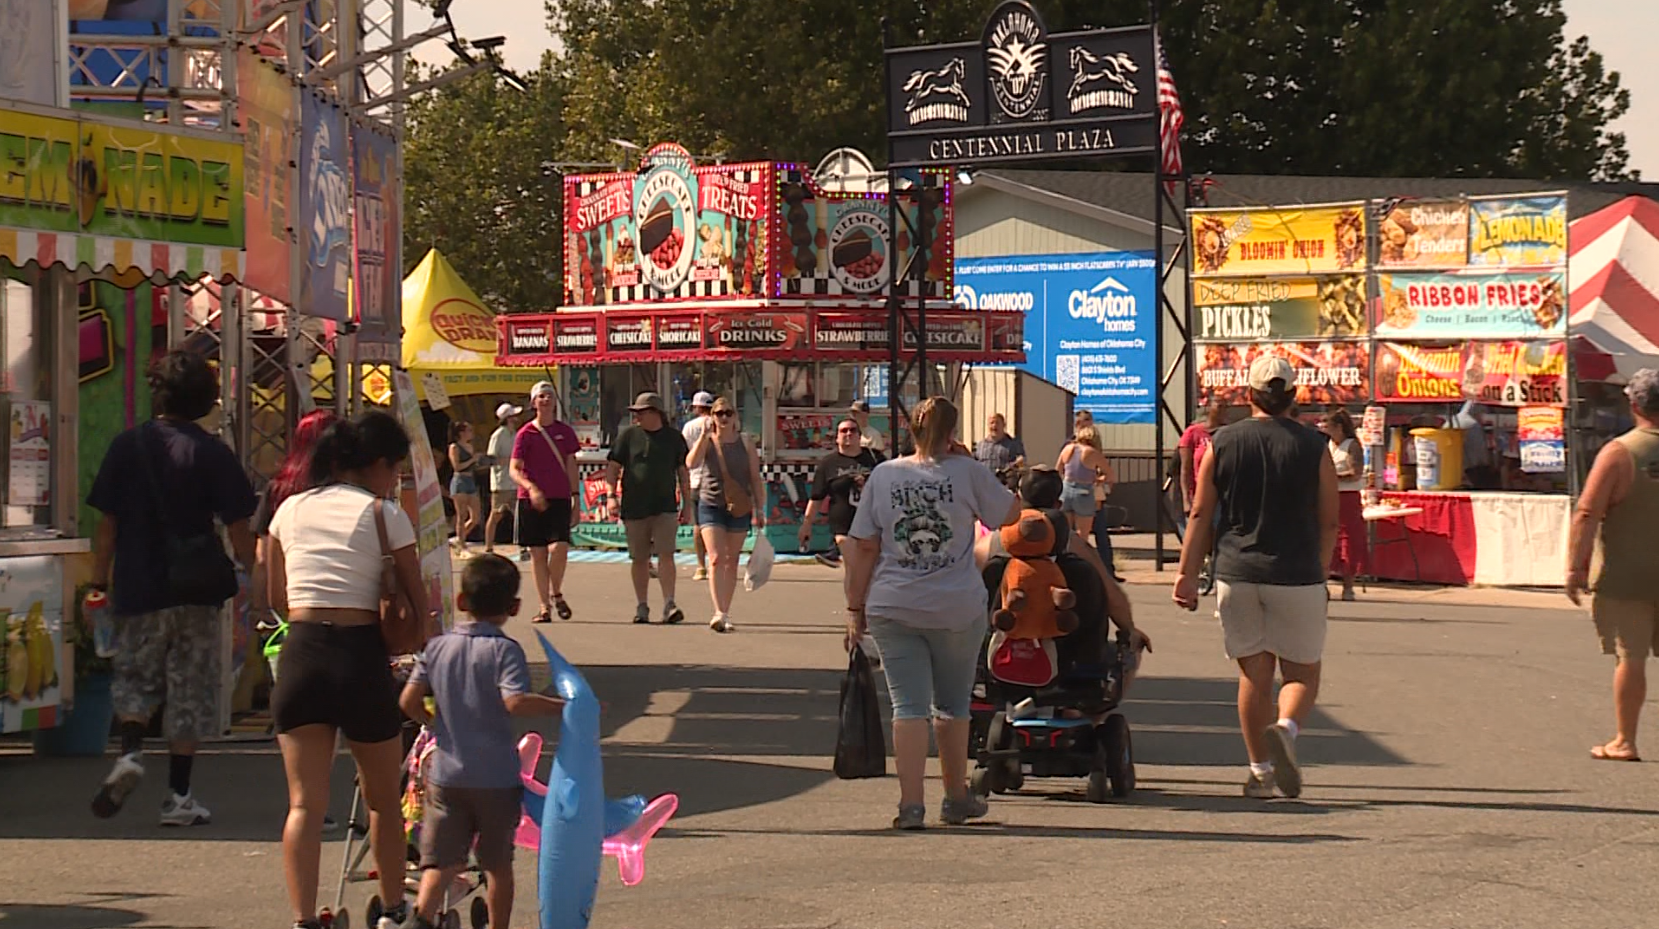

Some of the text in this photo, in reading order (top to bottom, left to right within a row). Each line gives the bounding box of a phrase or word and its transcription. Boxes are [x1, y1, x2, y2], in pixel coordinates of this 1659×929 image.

[991, 12, 1040, 48] OKLAHOMA
[930, 129, 1114, 160] CENTENNIAL PLAZA
[729, 178, 749, 195] FRIED
[576, 190, 630, 230] SWEETS
[702, 186, 757, 219] TREATS
[1411, 208, 1466, 226] Chicken
[1480, 214, 1565, 250] LEMONADE
[1240, 239, 1324, 260] BLOOMIN' ONION
[1412, 234, 1465, 253] Tenders
[1201, 280, 1291, 303] DEEP FRIED
[1408, 284, 1541, 307] RIBBON FRIES
[979, 292, 1034, 312] OAKWOOD
[1068, 289, 1137, 324] Clayton
[731, 318, 772, 328] Ice Cold
[1104, 318, 1136, 332] homes
[1201, 305, 1271, 337] PICKLES
[513, 335, 548, 348] BANANAS
[720, 330, 788, 342] DRINKS
[816, 331, 889, 343] STRAWBERRIE
[904, 331, 981, 344] CESECAKE
[1204, 369, 1251, 387] BUFFAL
[1397, 374, 1461, 397] Onions
[1482, 380, 1562, 402] on a Stick
[781, 418, 831, 431] SWEETS
